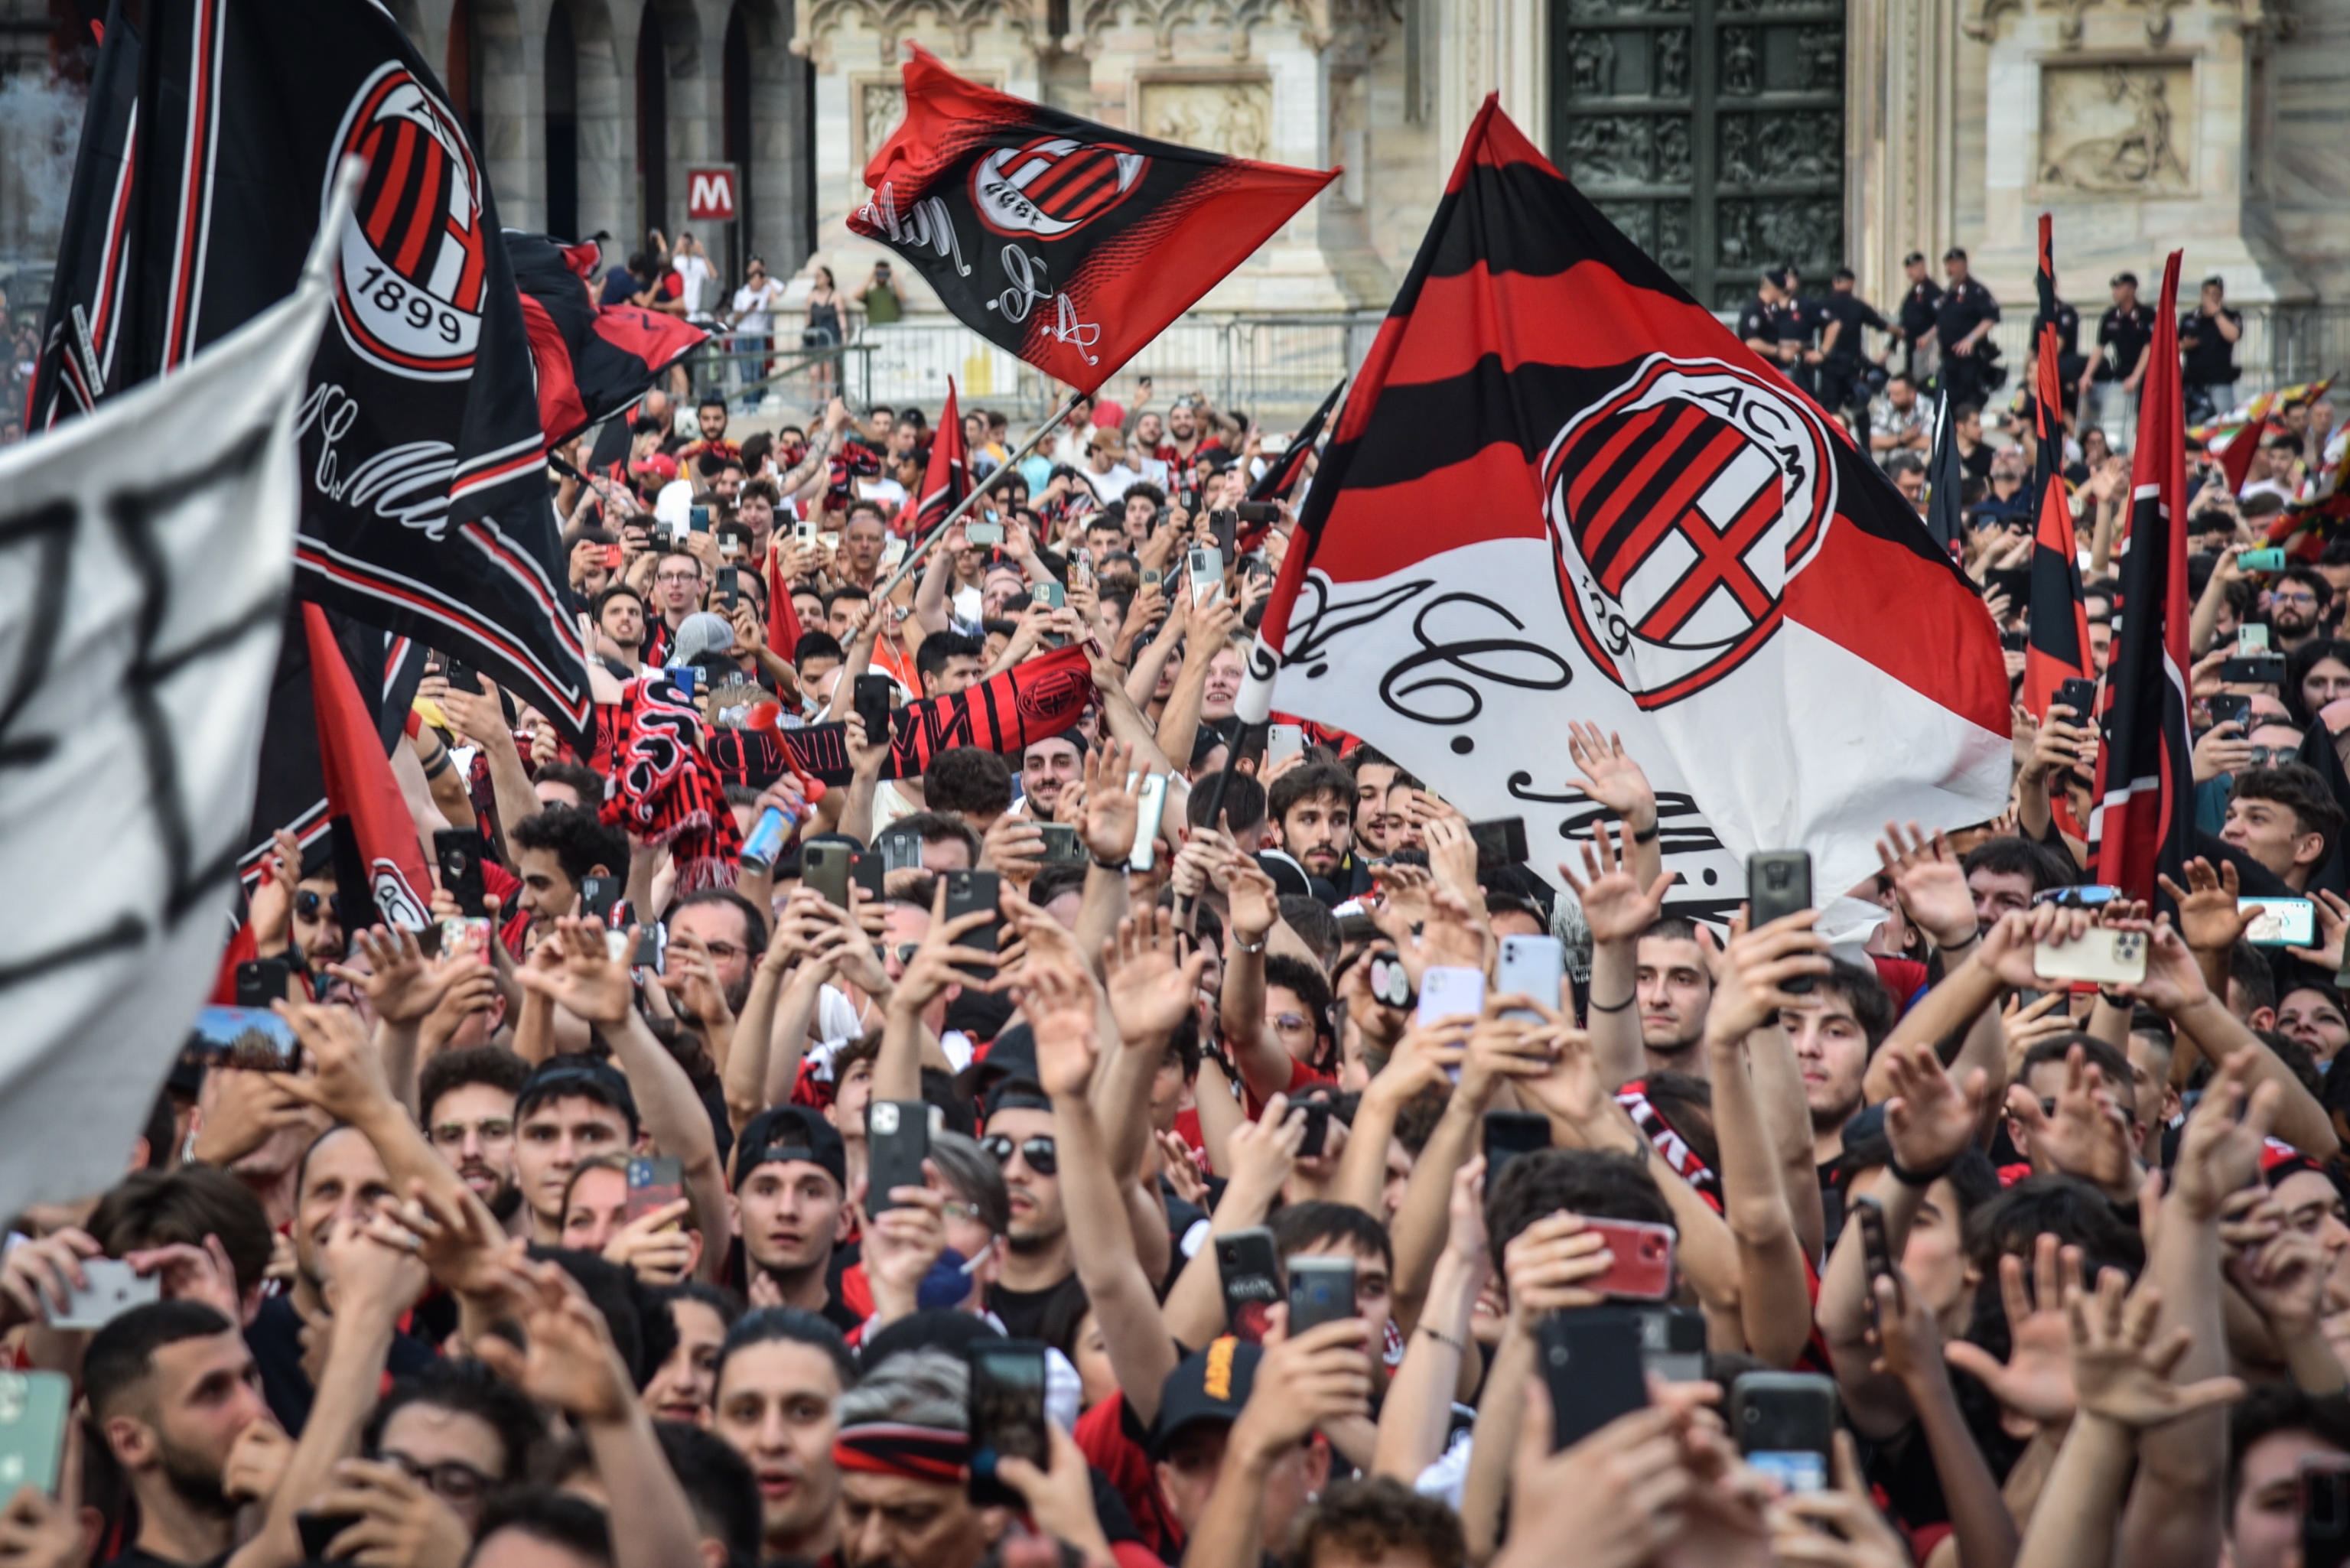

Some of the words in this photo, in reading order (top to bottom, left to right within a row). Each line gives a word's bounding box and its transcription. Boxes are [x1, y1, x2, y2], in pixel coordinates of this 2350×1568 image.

[691, 174, 732, 210] M
[356, 264, 462, 345] 1899
[1678, 386, 1806, 506] ACM
[379, 885, 417, 925] AC
